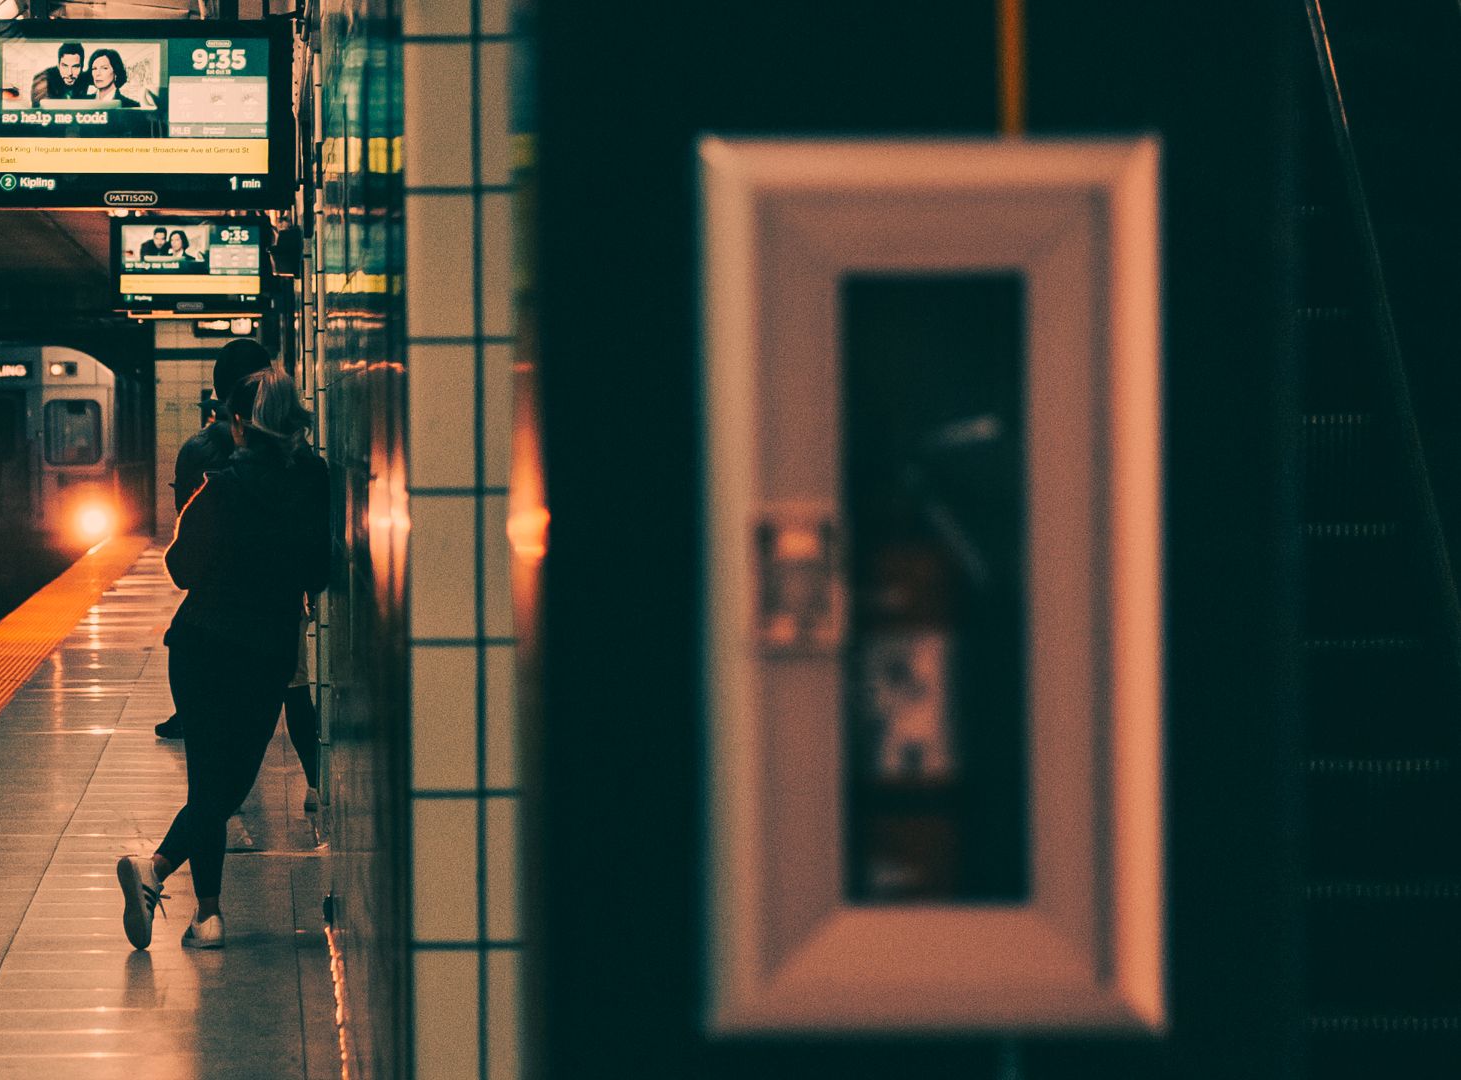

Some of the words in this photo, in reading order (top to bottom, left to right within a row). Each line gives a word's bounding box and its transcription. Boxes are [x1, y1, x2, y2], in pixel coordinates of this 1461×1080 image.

[192, 48, 247, 70] 9:35
[1, 113, 18, 124] so
[20, 111, 52, 126] help
[54, 113, 73, 124] me
[75, 111, 108, 124] todd
[171, 127, 191, 135] MLB
[34, 146, 61, 154] Regular
[4, 177, 12, 187] 2
[20, 176, 55, 189] Kipling
[229, 176, 237, 190] 1
[242, 178, 261, 188] min
[109, 193, 153, 203] PATTISON
[220, 229, 249, 241] 9:35
